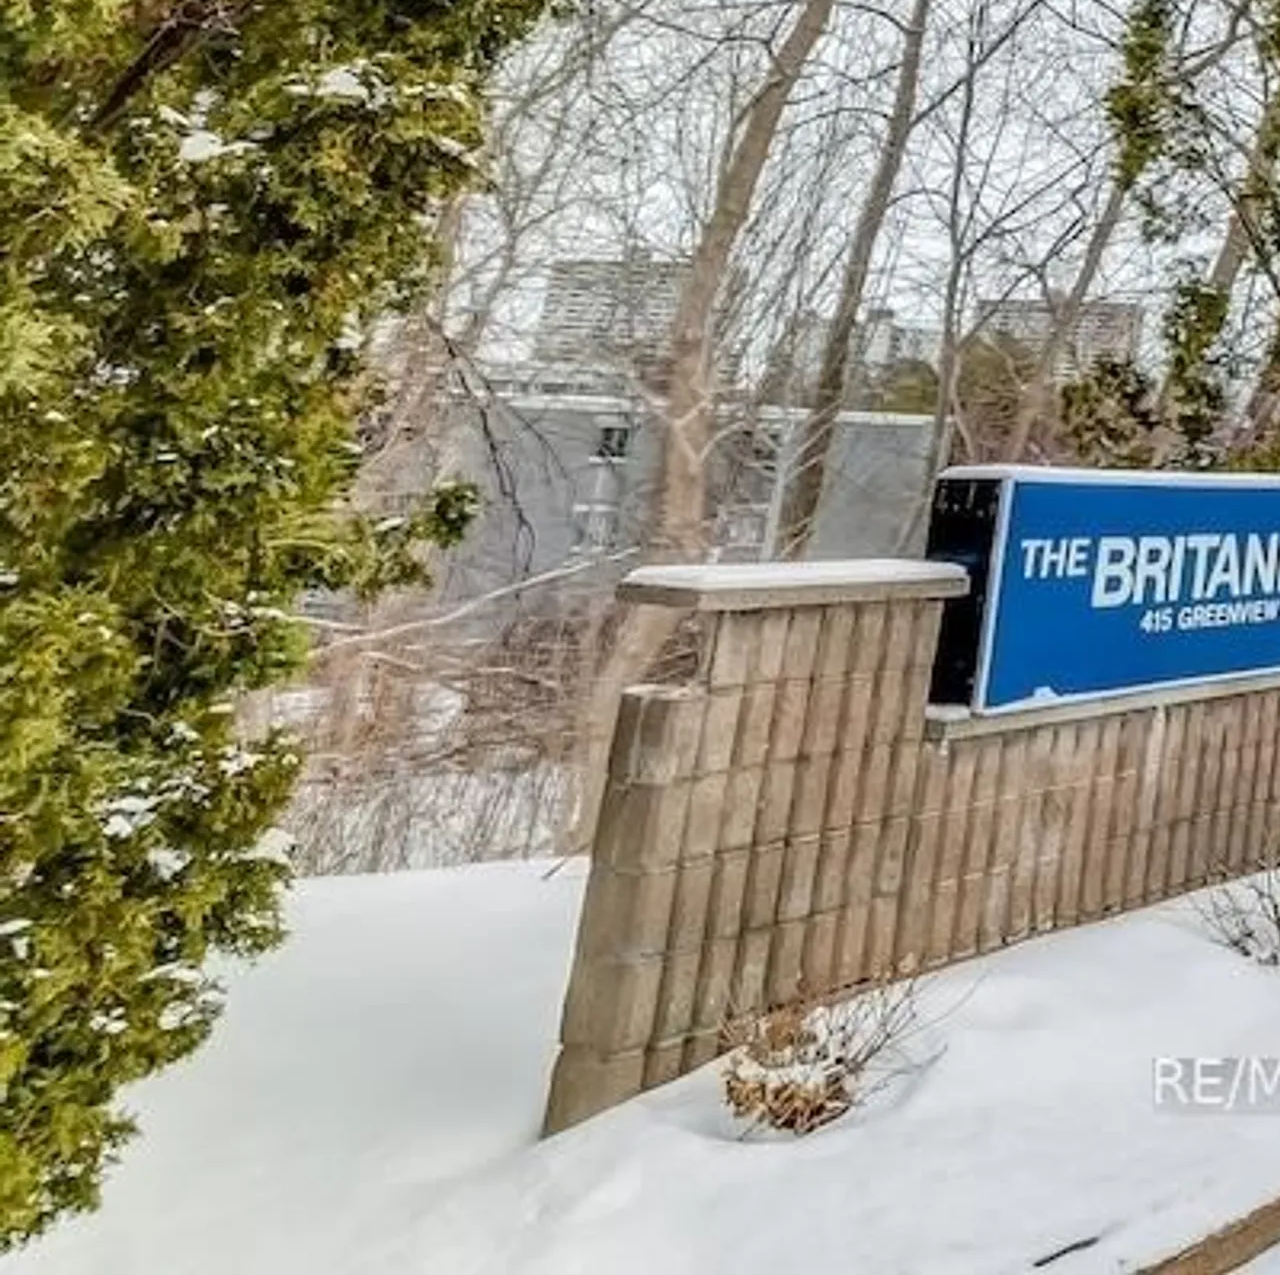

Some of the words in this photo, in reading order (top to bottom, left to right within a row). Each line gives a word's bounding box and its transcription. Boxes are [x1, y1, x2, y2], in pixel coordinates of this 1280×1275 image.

[1021, 538, 1092, 579] THE
[1140, 607, 1173, 633] 415
[1177, 601, 1279, 630] GREENVIEW
